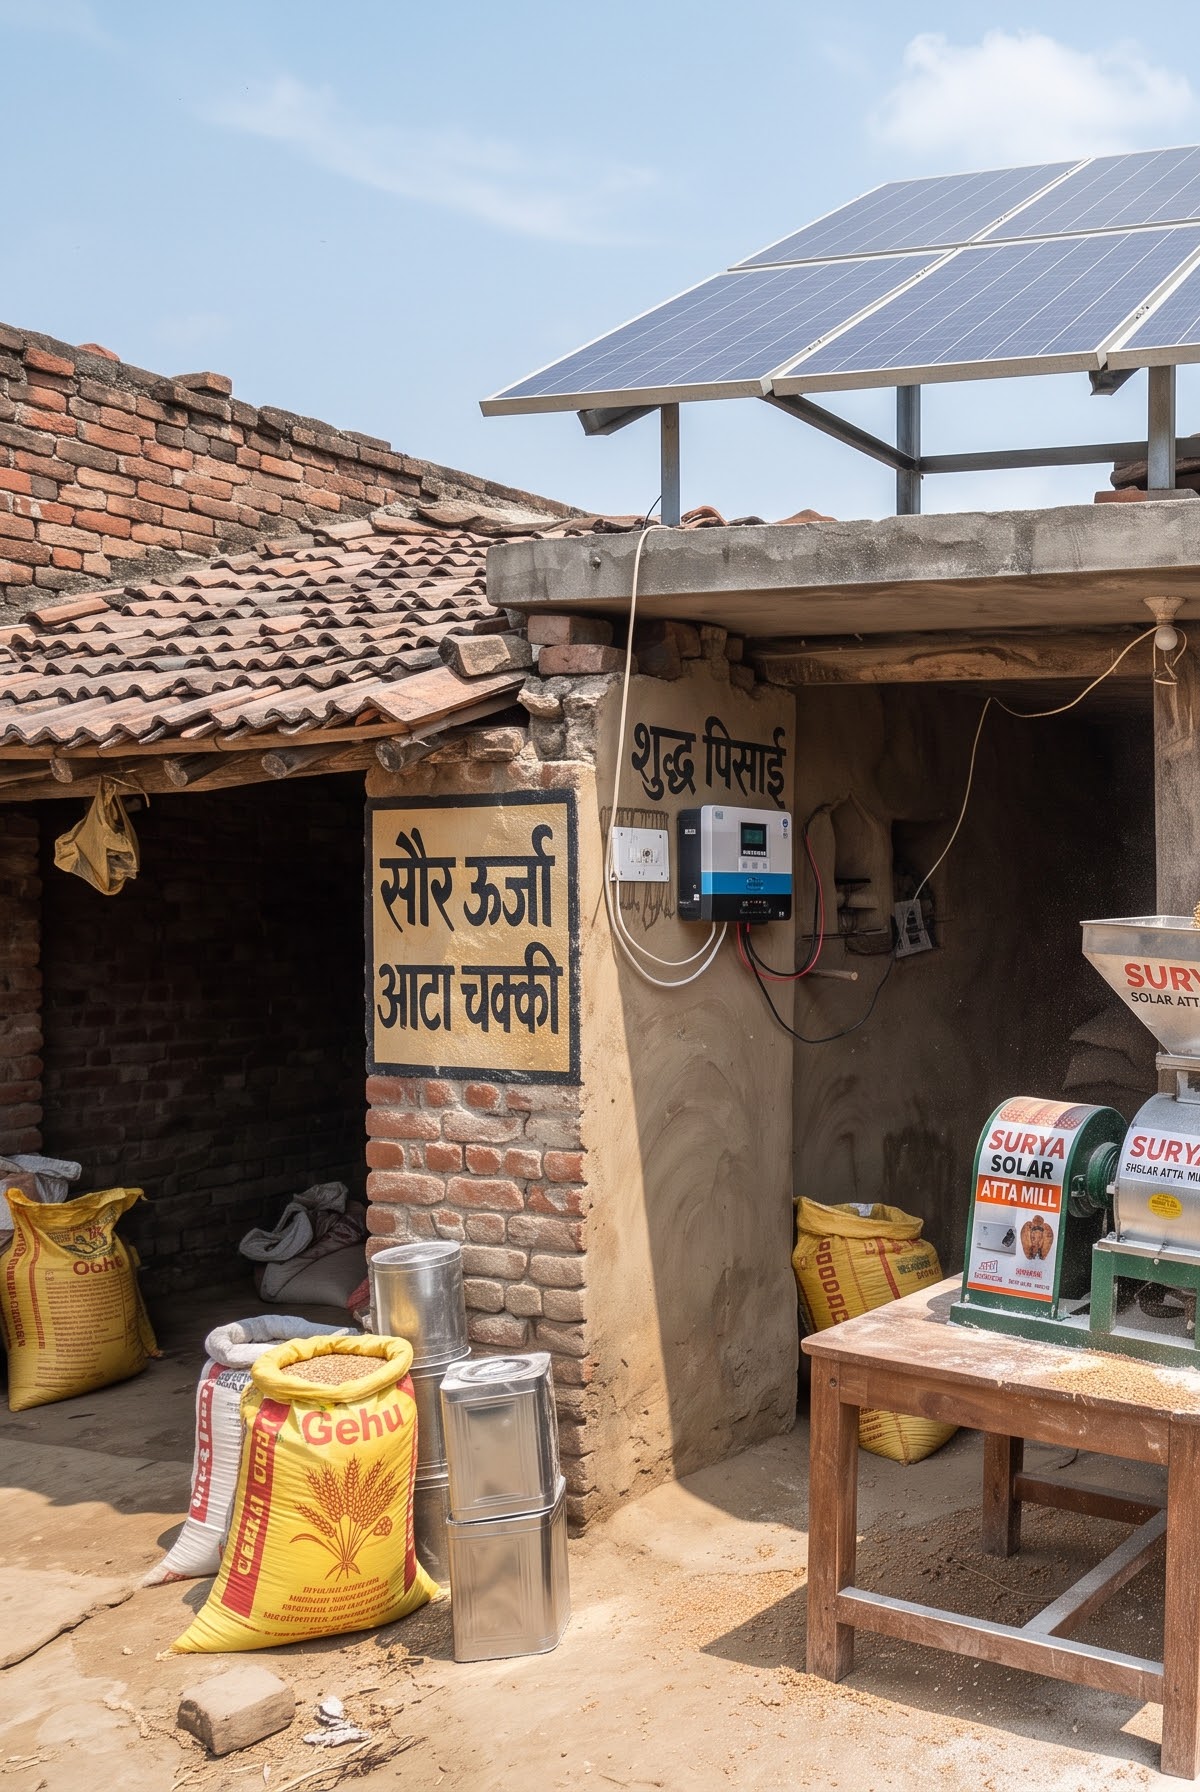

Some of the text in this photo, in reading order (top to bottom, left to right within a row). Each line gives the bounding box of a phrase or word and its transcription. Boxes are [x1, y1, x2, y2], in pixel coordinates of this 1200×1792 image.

[631, 716, 787, 809] शुद्ध पिसाई
[379, 824, 556, 933] सौर ऊर्जा
[377, 941, 564, 1035] आटा चक्की
[1131, 991, 1174, 1006] SOLAR
[988, 1129, 1065, 1160] SURYA
[990, 1154, 1054, 1180] SOLAR
[981, 1179, 1057, 1208] ATTA MILL
[301, 1402, 405, 1446] Gehu
